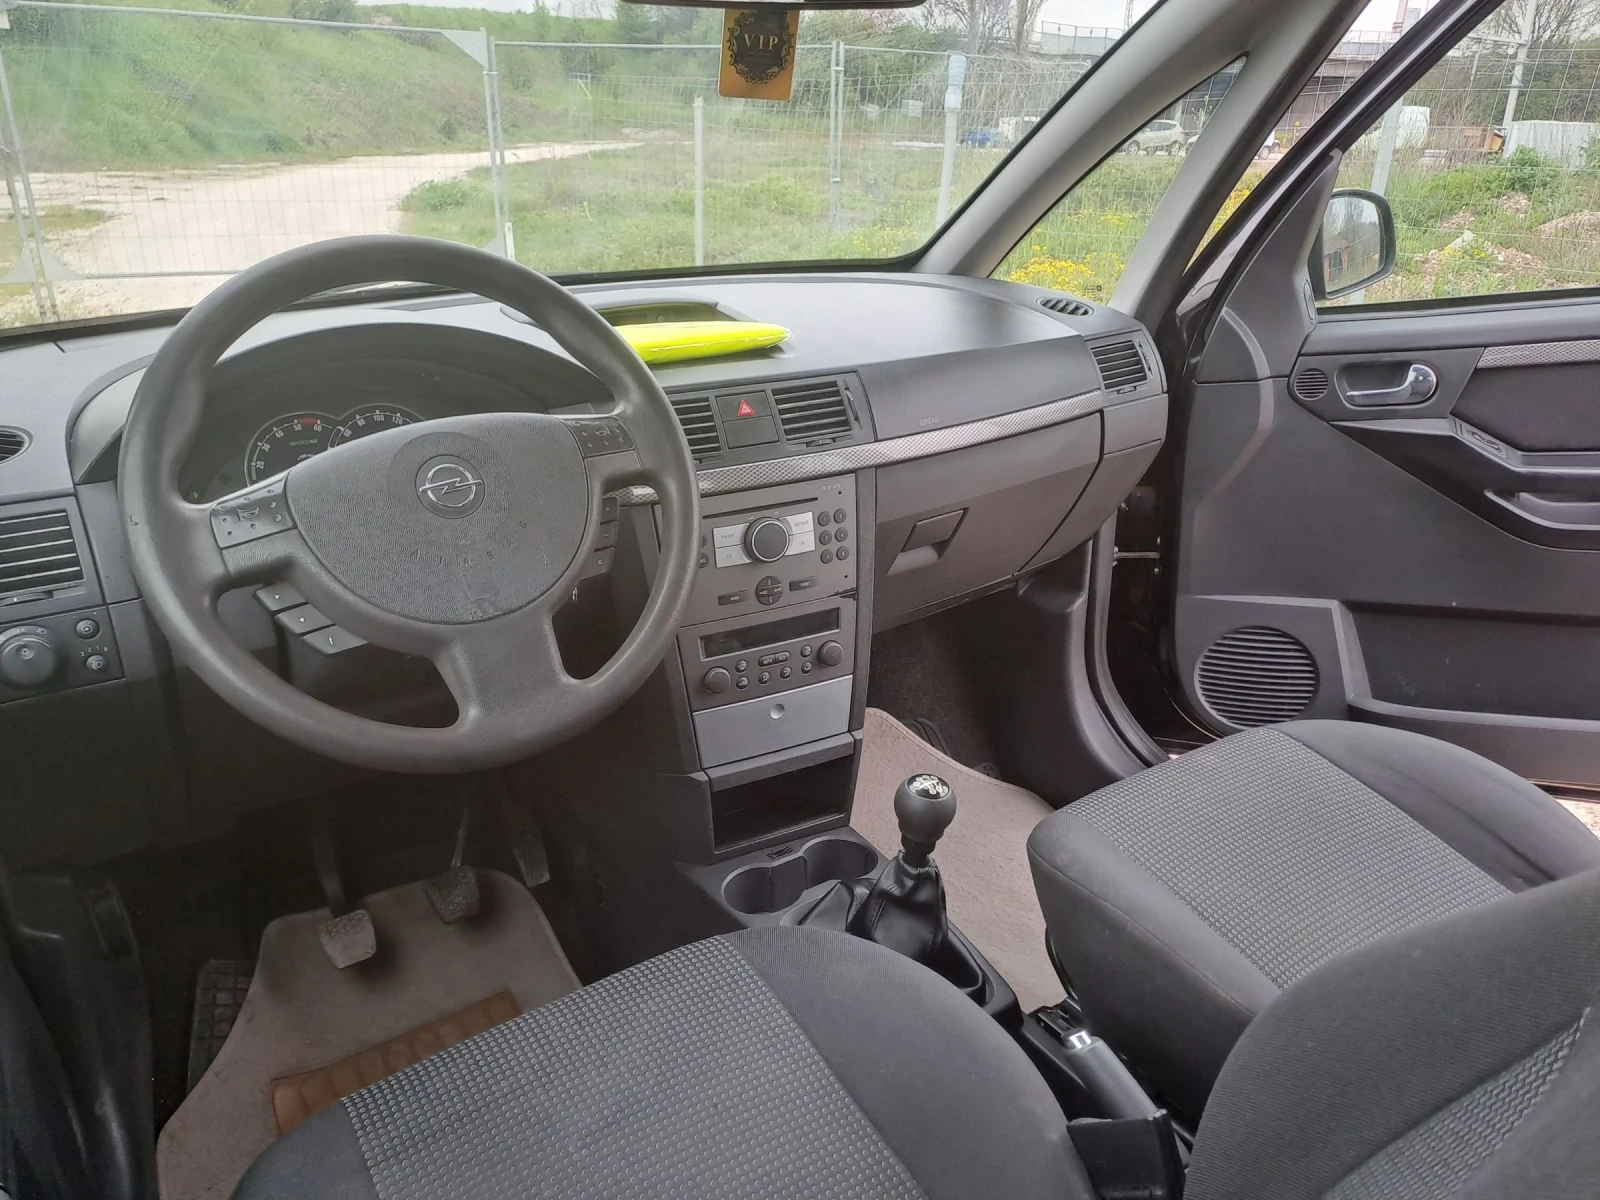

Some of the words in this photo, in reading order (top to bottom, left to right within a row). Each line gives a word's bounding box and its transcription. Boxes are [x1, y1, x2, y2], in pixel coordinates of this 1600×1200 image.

[743, 33, 779, 50] VIP
[356, 418, 366, 427] 80
[373, 414, 384, 422] 100
[391, 415, 403, 425] 120
[919, 416, 940, 427] AIRBAG
[293, 424, 302, 432] 50
[313, 424, 322, 432] 60
[274, 430, 284, 439] 40
[261, 442, 271, 452] 30
[256, 460, 265, 469] 20
